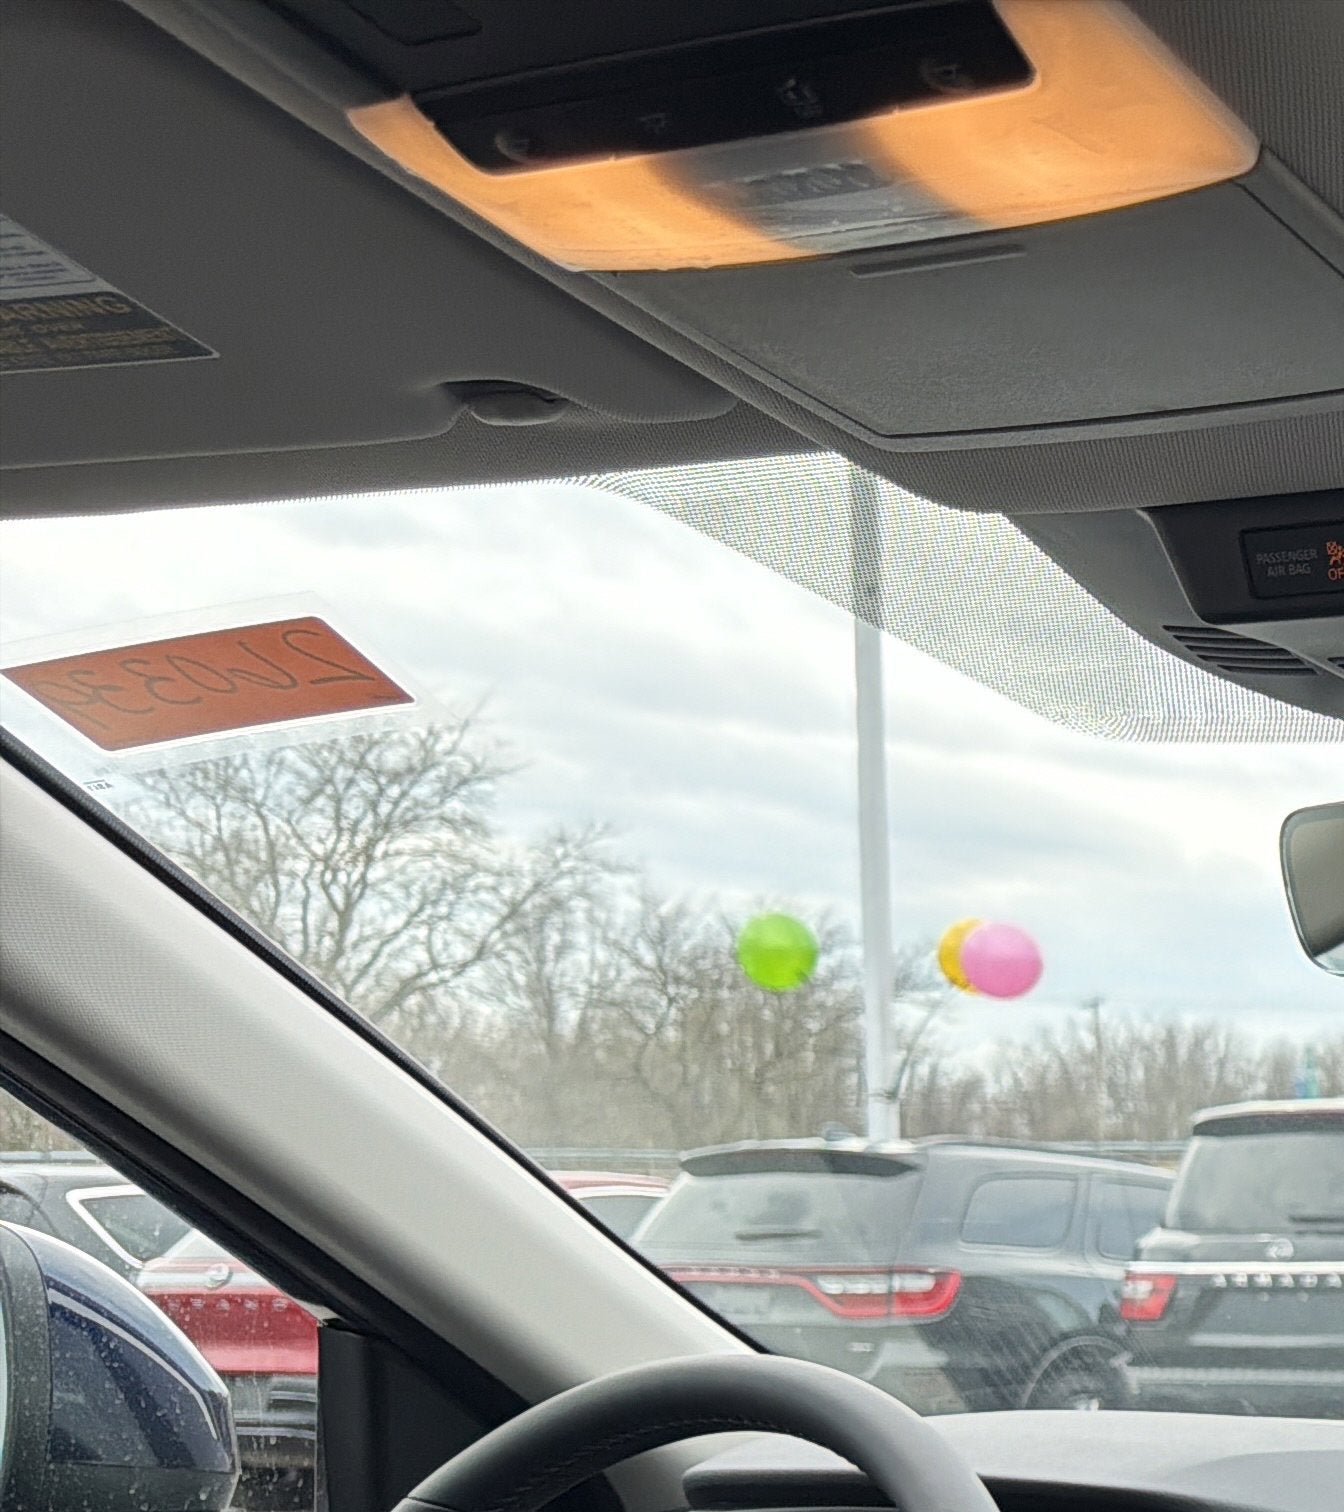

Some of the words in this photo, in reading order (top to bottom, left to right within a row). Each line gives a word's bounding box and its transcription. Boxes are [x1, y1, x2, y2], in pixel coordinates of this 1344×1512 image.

[1256, 549, 1318, 564] PASSENGER
[1267, 565, 1286, 577] AIR
[1288, 563, 1311, 575] BAG
